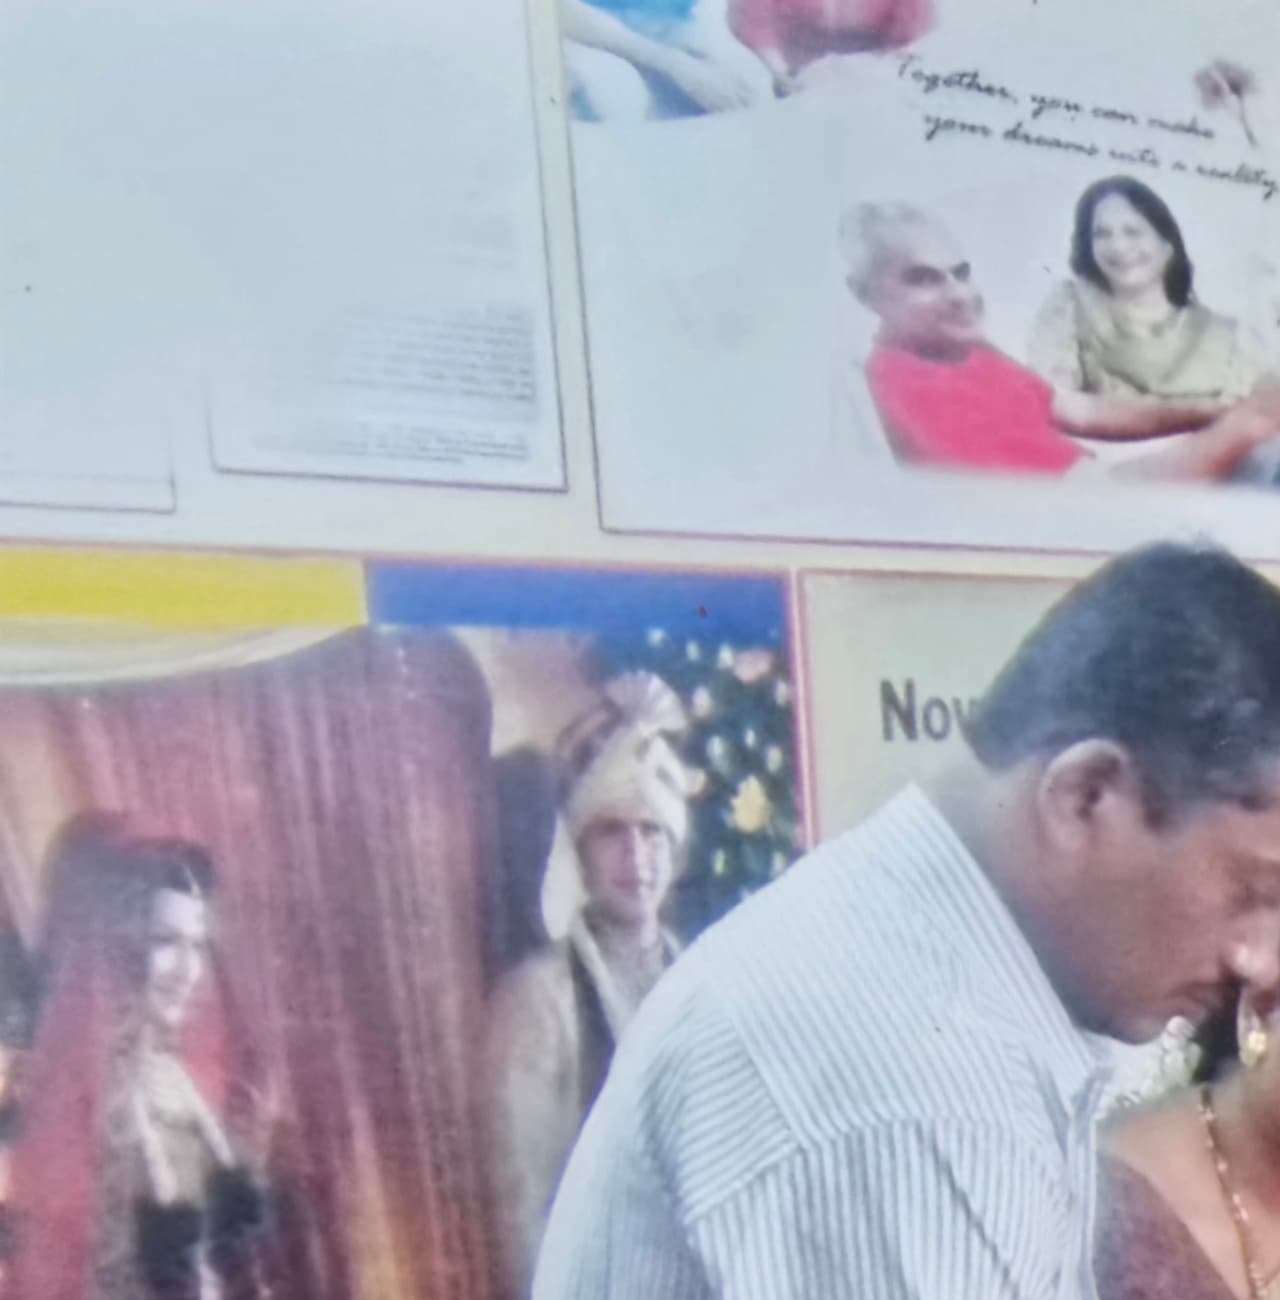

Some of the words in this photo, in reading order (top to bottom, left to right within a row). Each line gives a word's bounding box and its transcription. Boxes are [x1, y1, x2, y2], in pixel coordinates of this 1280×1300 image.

[924, 114, 992, 141] your
[1003, 121, 1100, 157] dreams
[1029, 96, 1082, 120] you
[1091, 107, 1138, 126] can
[1147, 116, 1215, 140] make
